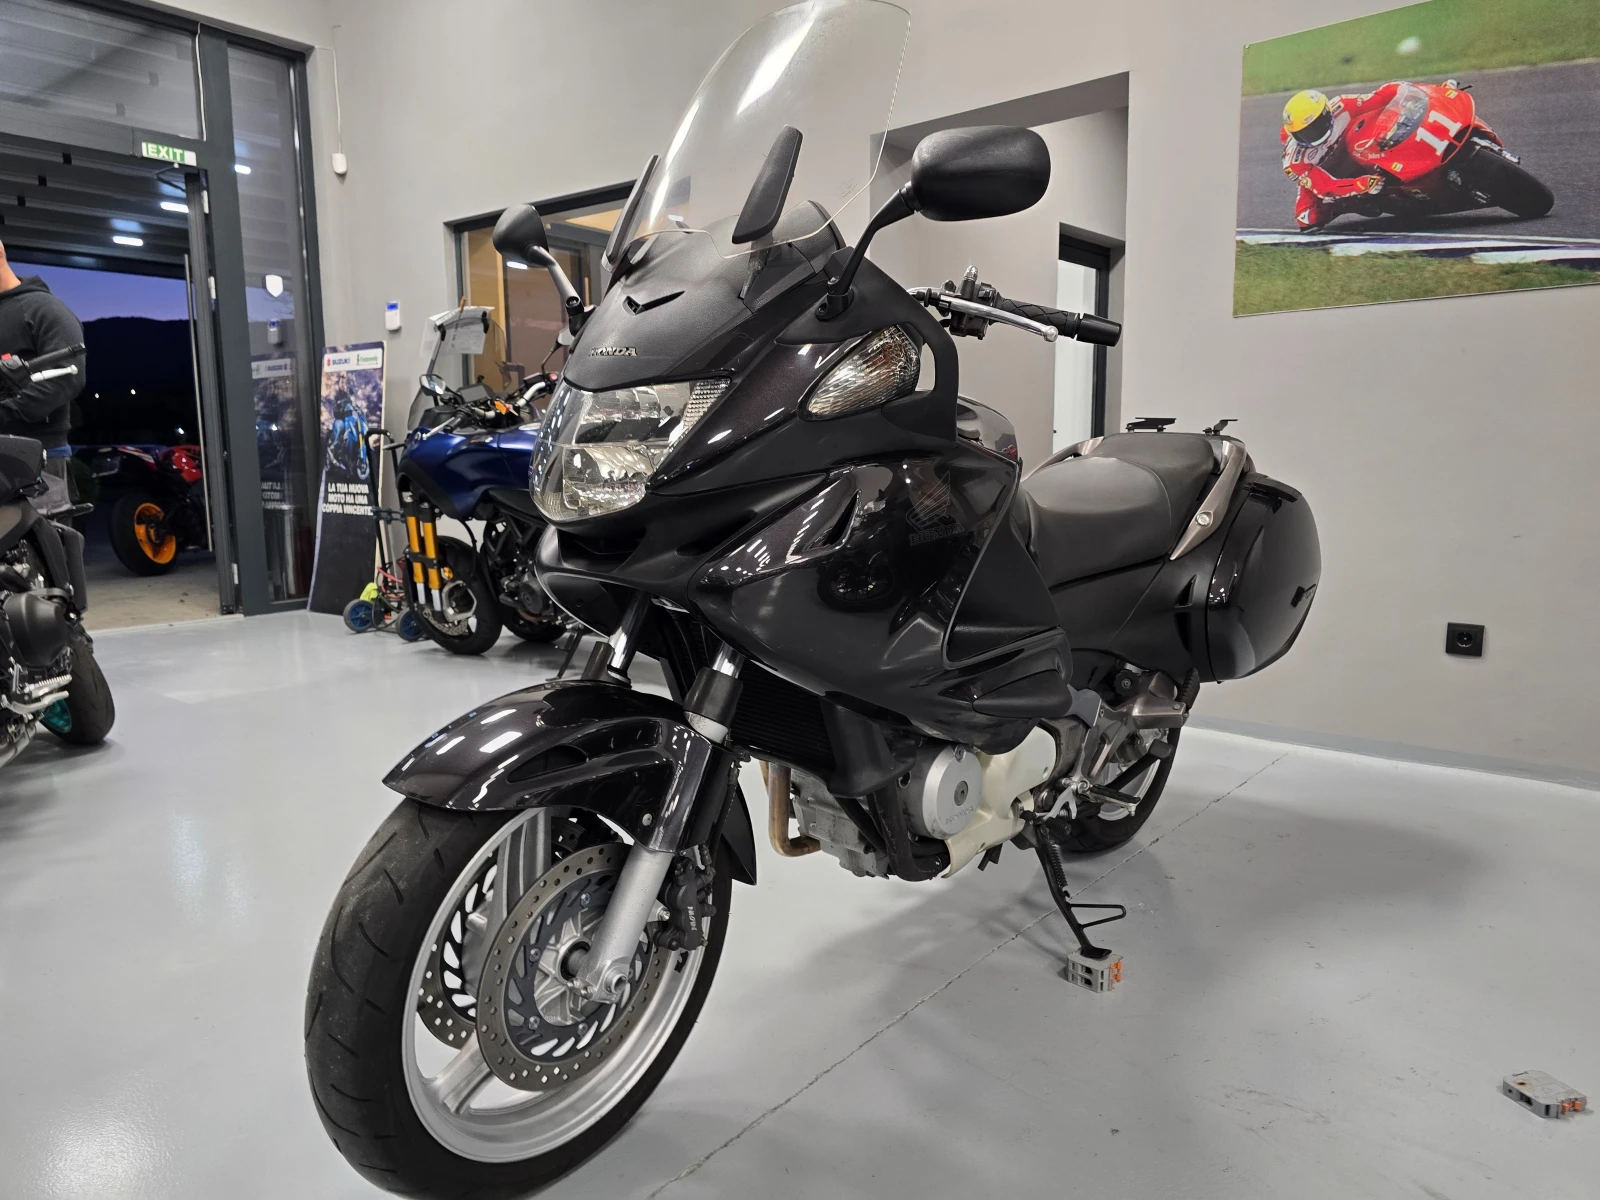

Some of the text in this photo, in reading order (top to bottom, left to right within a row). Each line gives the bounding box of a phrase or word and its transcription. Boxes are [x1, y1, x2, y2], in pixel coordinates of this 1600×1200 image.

[1415, 110, 1462, 156] 11
[148, 143, 183, 162] EXIT
[588, 346, 637, 357] HONDA
[328, 482, 369, 494] LA TUA NUOVA
[328, 493, 368, 504] MOTO HA UNA
[322, 503, 343, 513] COPPIA
[909, 523, 965, 546] HONDA
